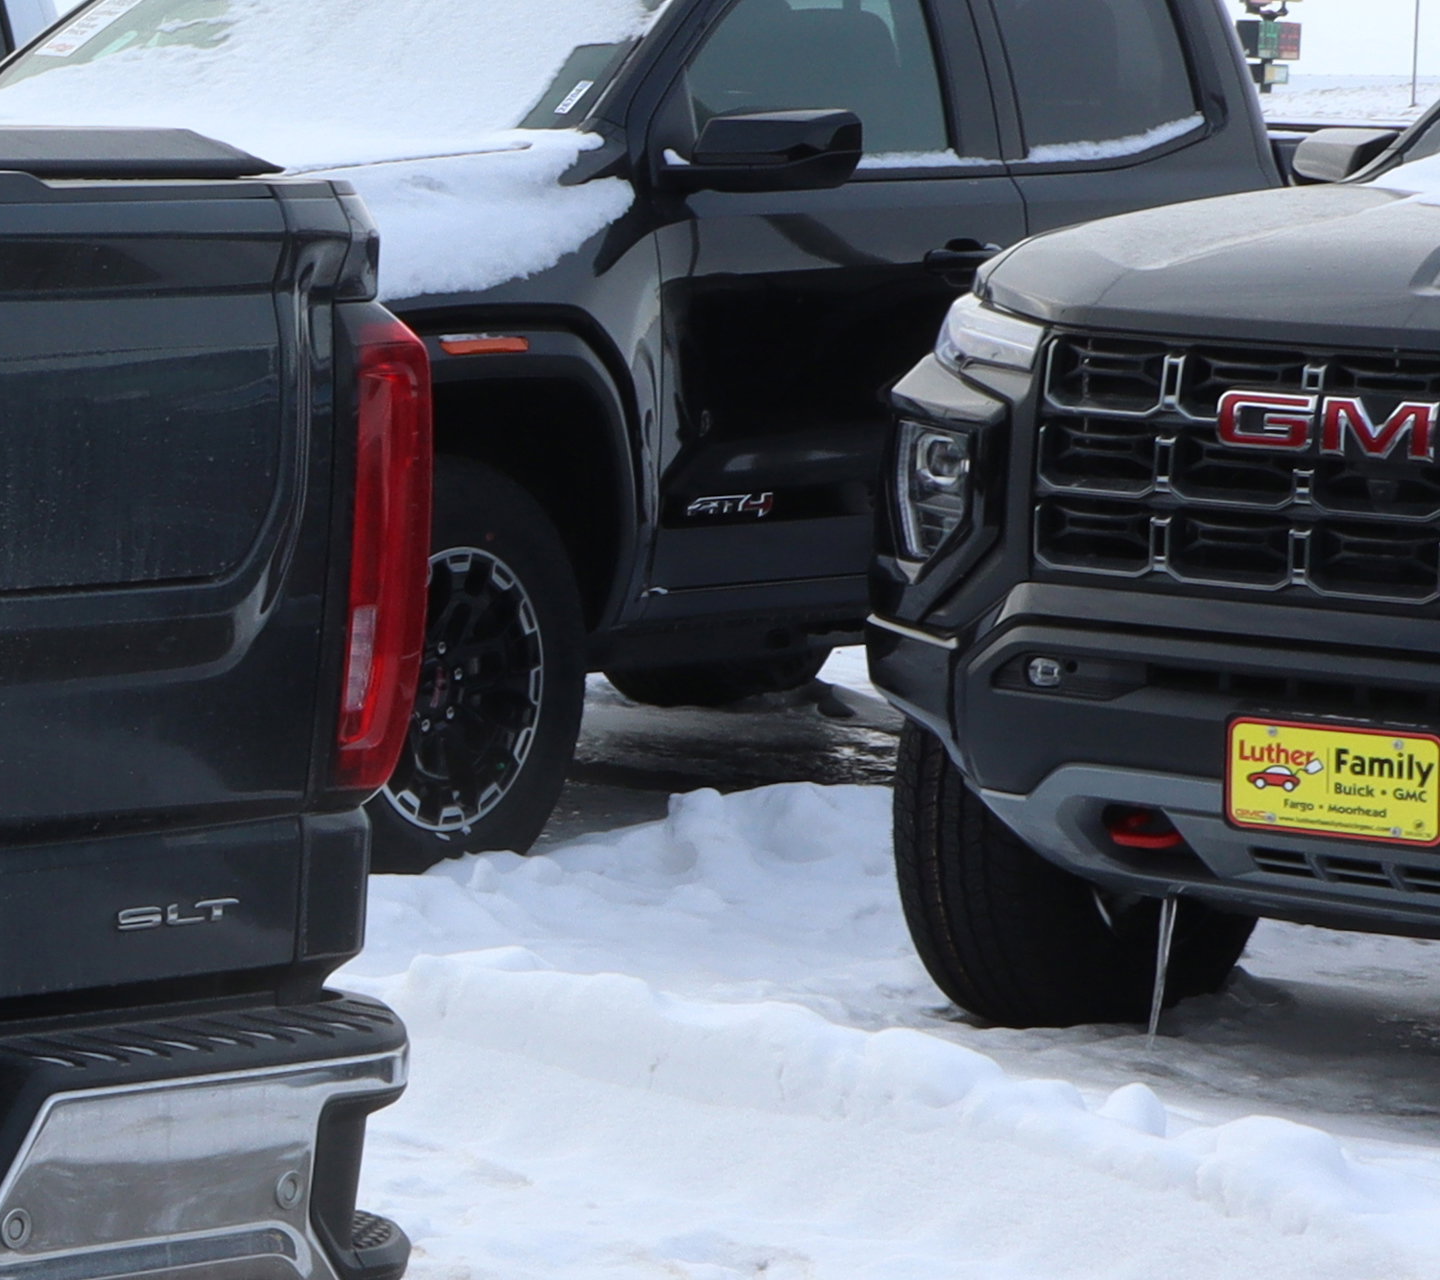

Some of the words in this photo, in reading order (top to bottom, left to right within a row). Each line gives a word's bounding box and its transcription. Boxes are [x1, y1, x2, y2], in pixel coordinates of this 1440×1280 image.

[1217, 390, 1439, 462] GM
[1239, 739, 1315, 767] Luther
[1335, 748, 1434, 788] Family
[1283, 798, 1314, 812] Fargo
[1328, 804, 1387, 819] Moorhead
[1334, 782, 1375, 798] Buick
[1393, 788, 1427, 803] GMC
[118, 898, 240, 931] SLT
